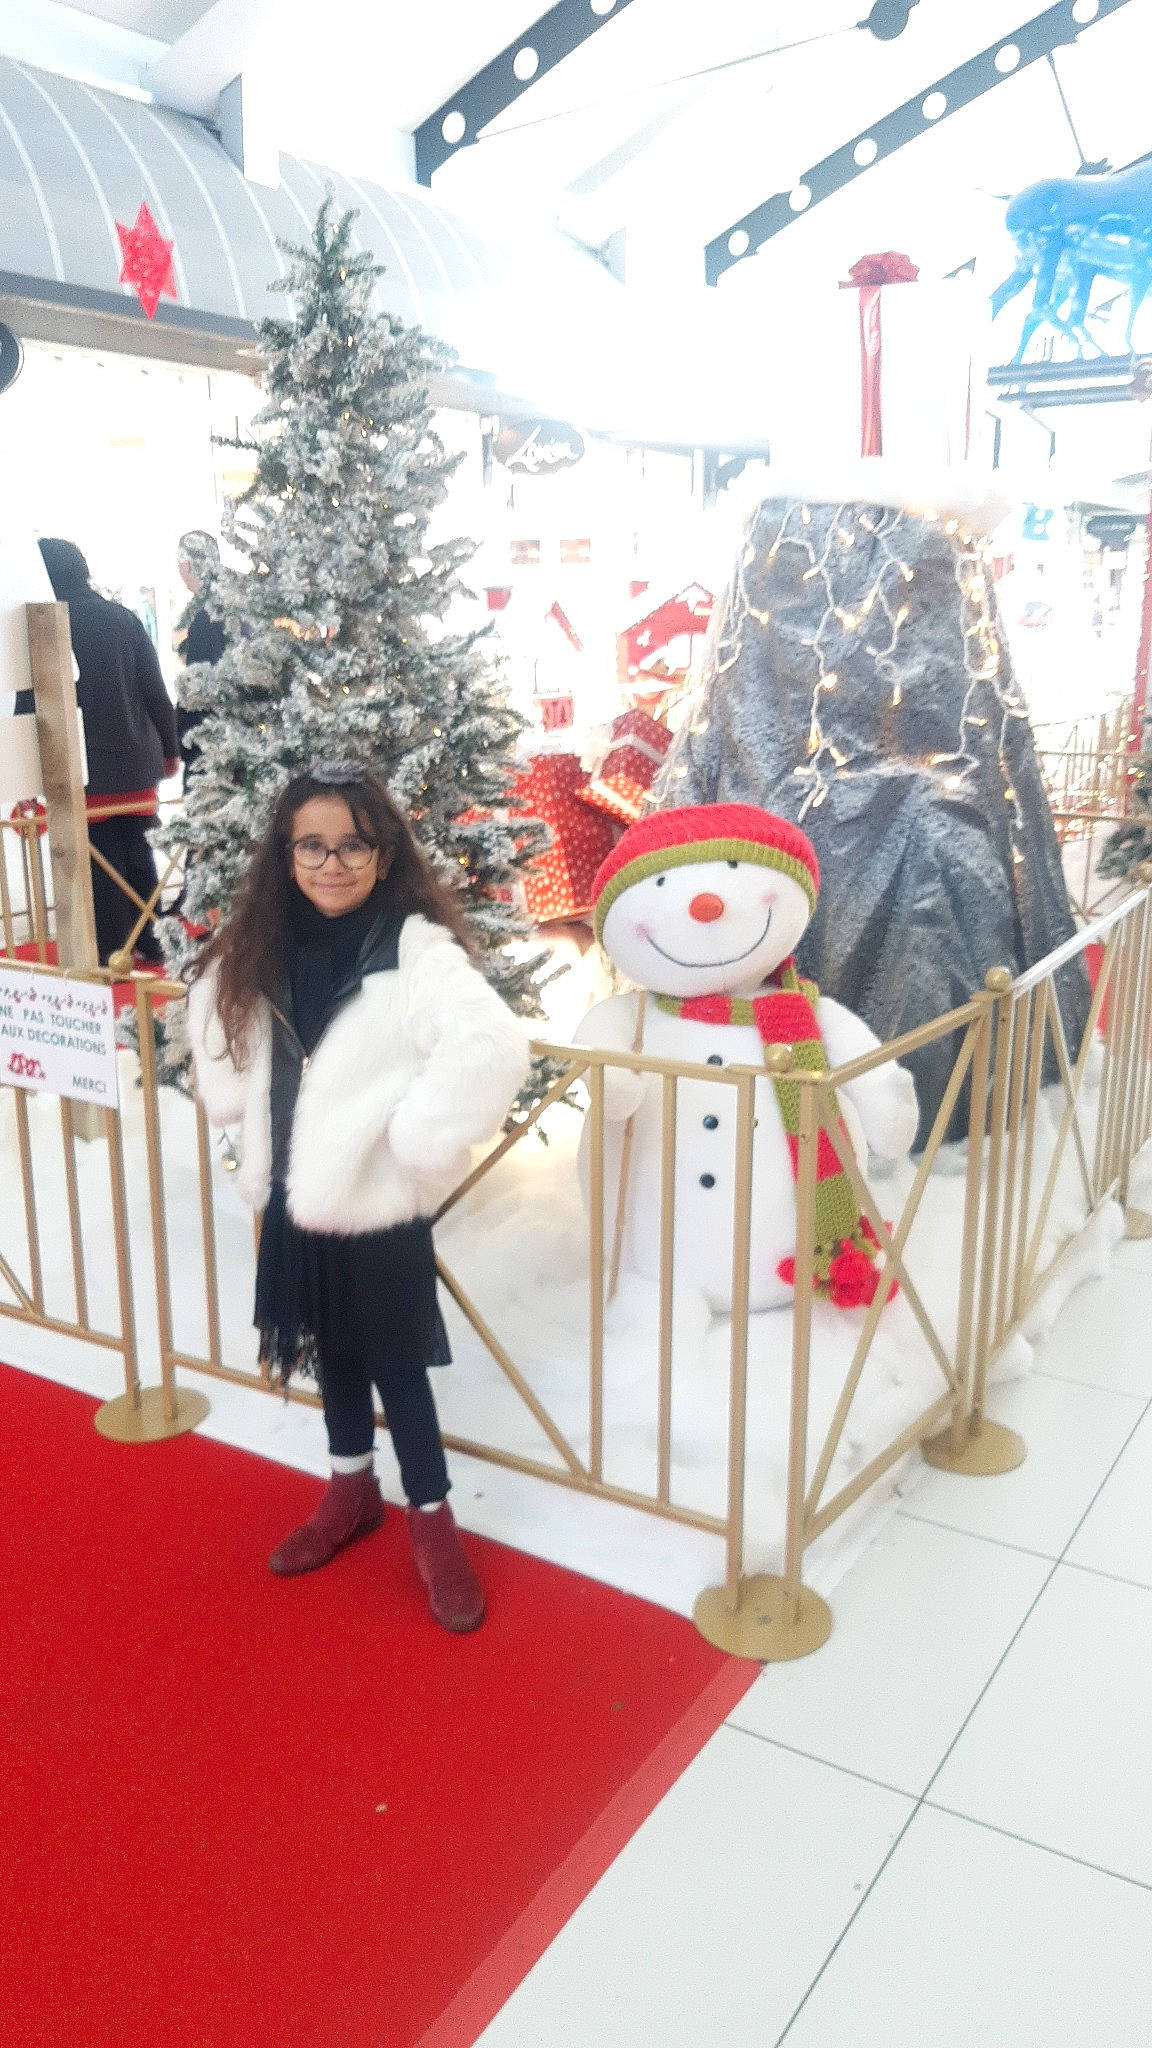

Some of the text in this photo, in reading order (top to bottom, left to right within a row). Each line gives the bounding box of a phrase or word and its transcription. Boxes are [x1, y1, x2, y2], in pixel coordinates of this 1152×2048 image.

[0, 1003, 101, 1035] NE PAS TOUCHER
[1, 1023, 106, 1055] AUX DECORATIONS
[72, 1075, 106, 1093] MERCI
